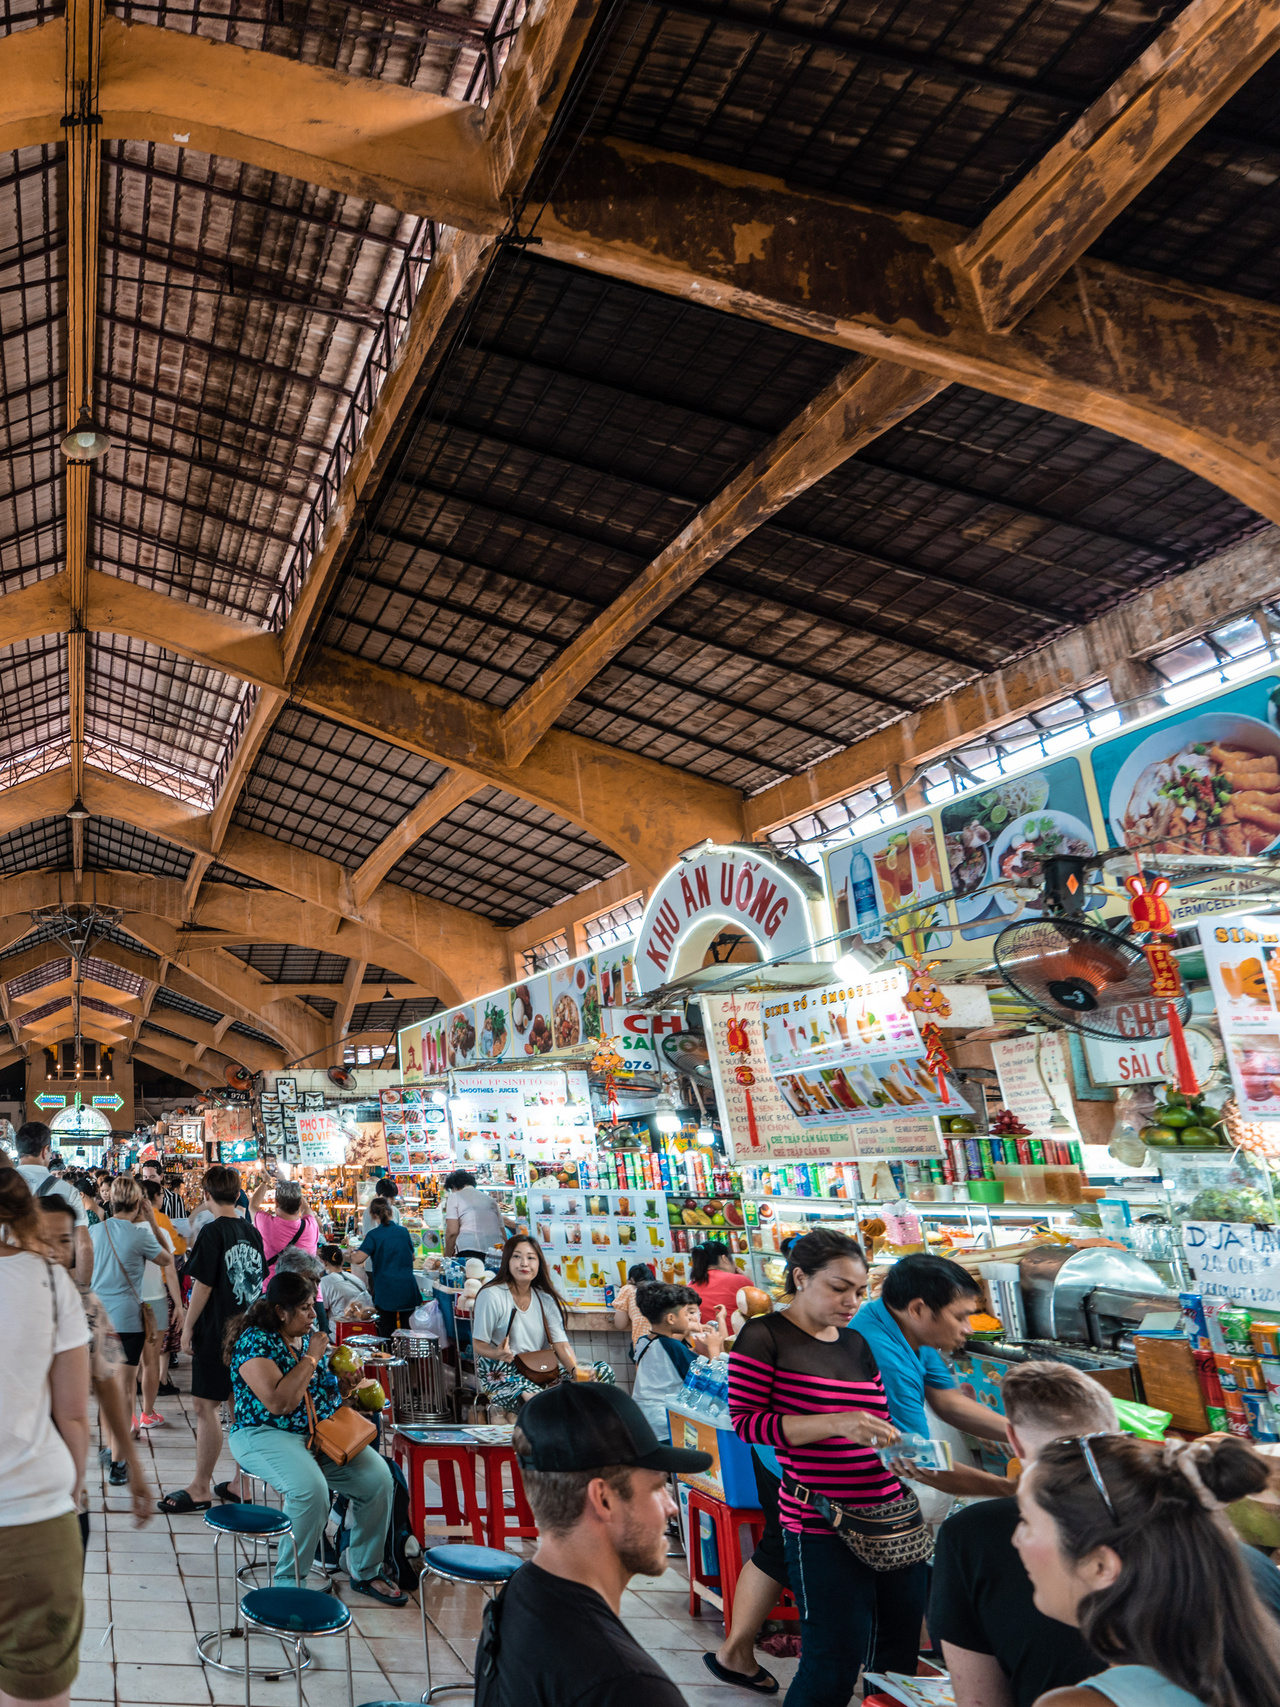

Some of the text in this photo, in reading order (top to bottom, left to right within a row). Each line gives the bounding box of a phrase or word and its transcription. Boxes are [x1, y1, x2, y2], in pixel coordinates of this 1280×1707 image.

[646, 861, 789, 974] KHU ĂN UỐNG
[765, 977, 899, 1018] SINH TỐ SMOOTHIES
[1119, 1047, 1151, 1080] SÀI
[489, 1076, 501, 1086] ÉP
[503, 1078, 526, 1086] SINH
[529, 1075, 542, 1086] TỐ
[818, 1146, 830, 1156] SEN
